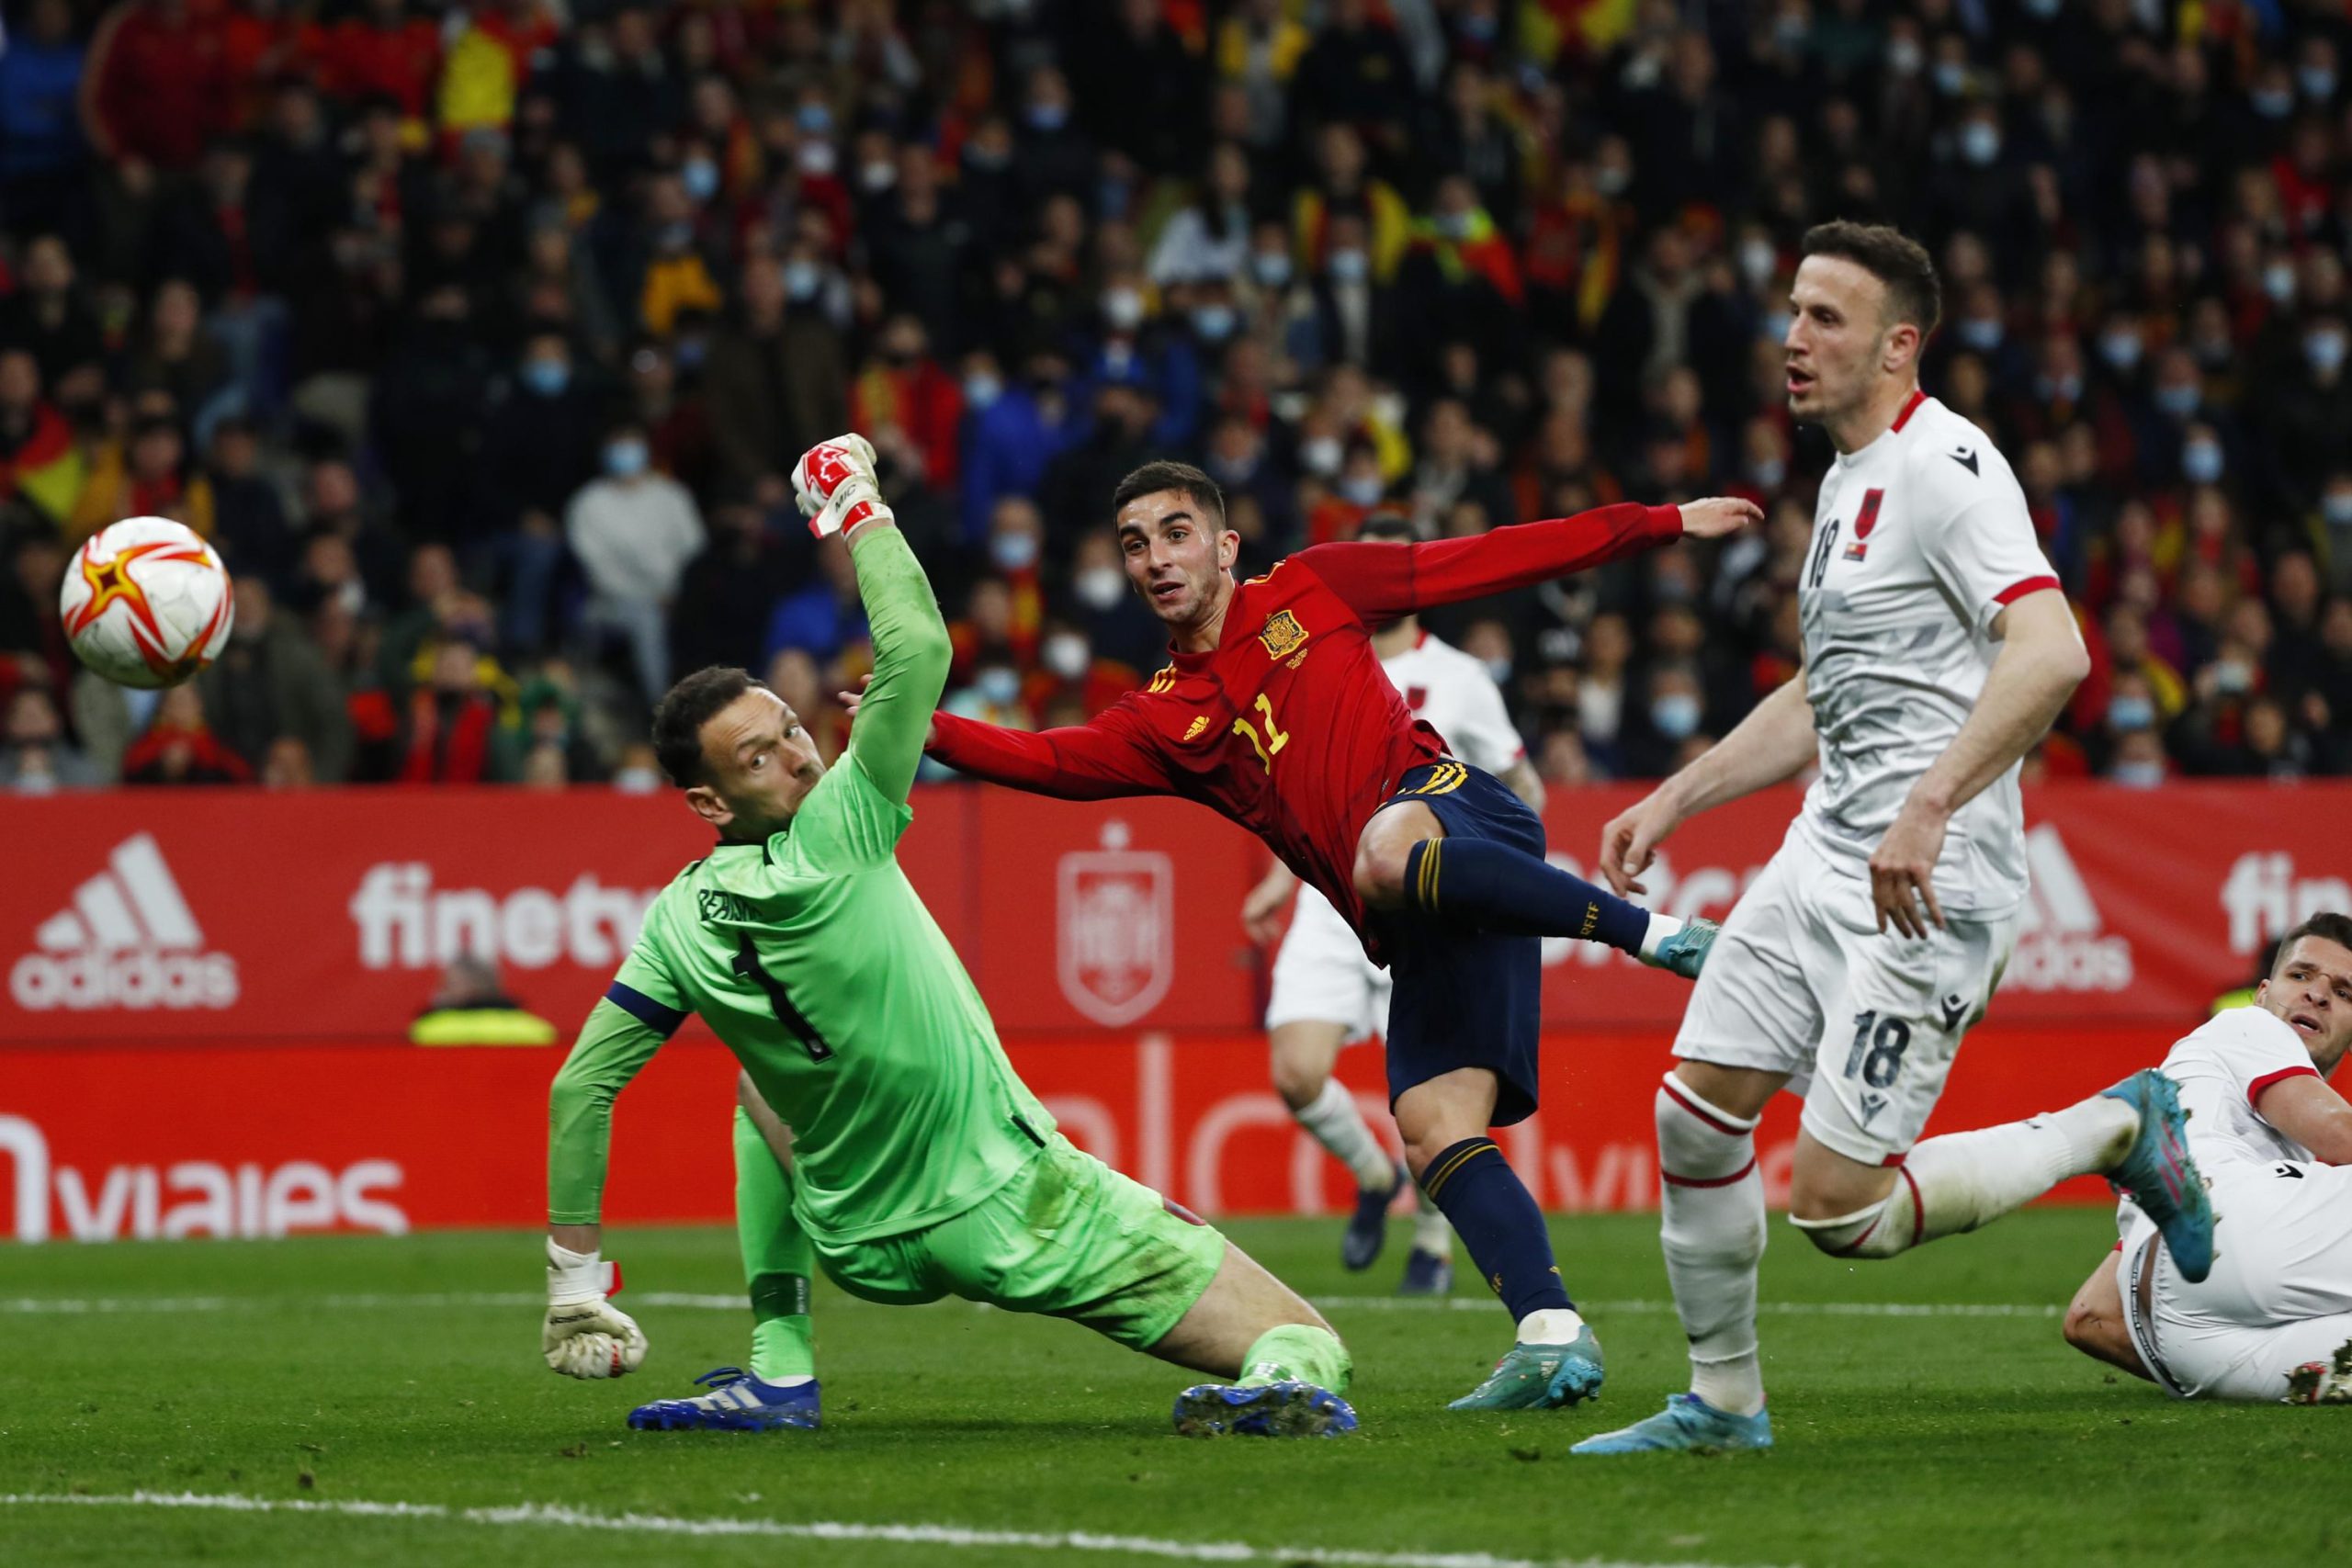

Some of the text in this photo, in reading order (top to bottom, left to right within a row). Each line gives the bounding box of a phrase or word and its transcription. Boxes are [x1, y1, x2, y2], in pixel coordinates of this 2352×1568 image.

[1809, 518, 1839, 589] 18
[1232, 693, 1289, 775] 11
[11, 952, 241, 1009] adidas
[729, 931, 835, 1066] 1
[1844, 1009, 1911, 1089] 18
